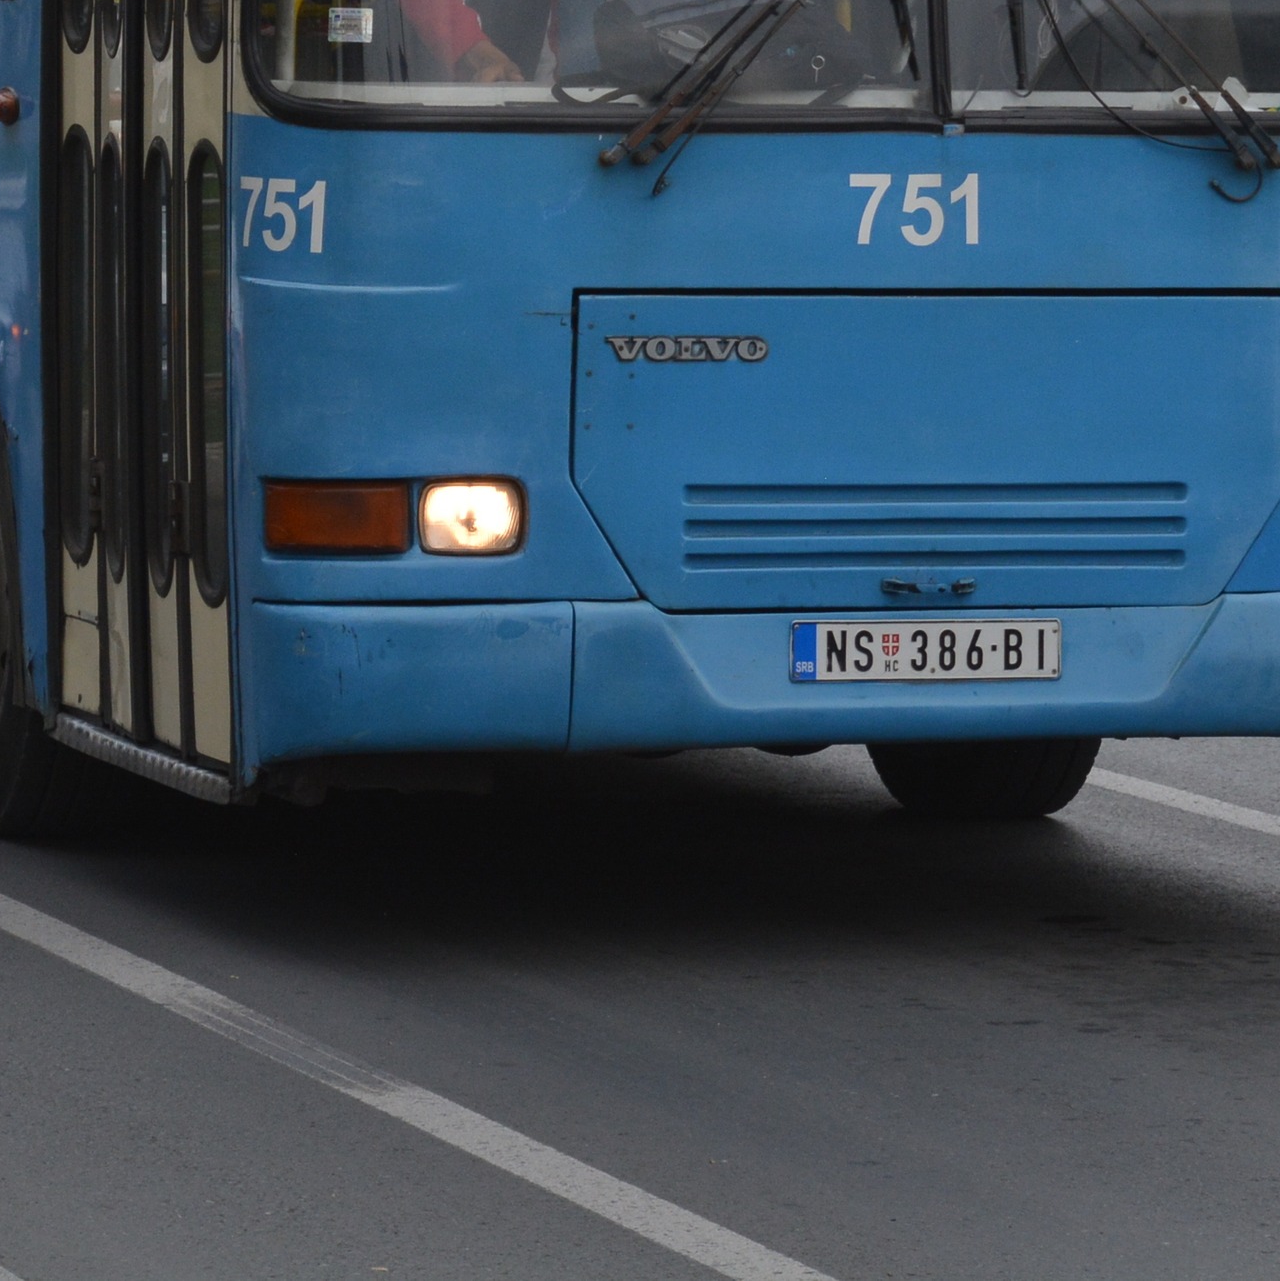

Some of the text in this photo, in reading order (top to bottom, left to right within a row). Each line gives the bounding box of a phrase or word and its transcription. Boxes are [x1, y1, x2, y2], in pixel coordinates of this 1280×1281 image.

[240, 176, 327, 254] 751
[849, 173, 979, 247] 751
[605, 335, 769, 362] VOLVO
[795, 661, 814, 673] SRB
[825, 629, 874, 673] NS
